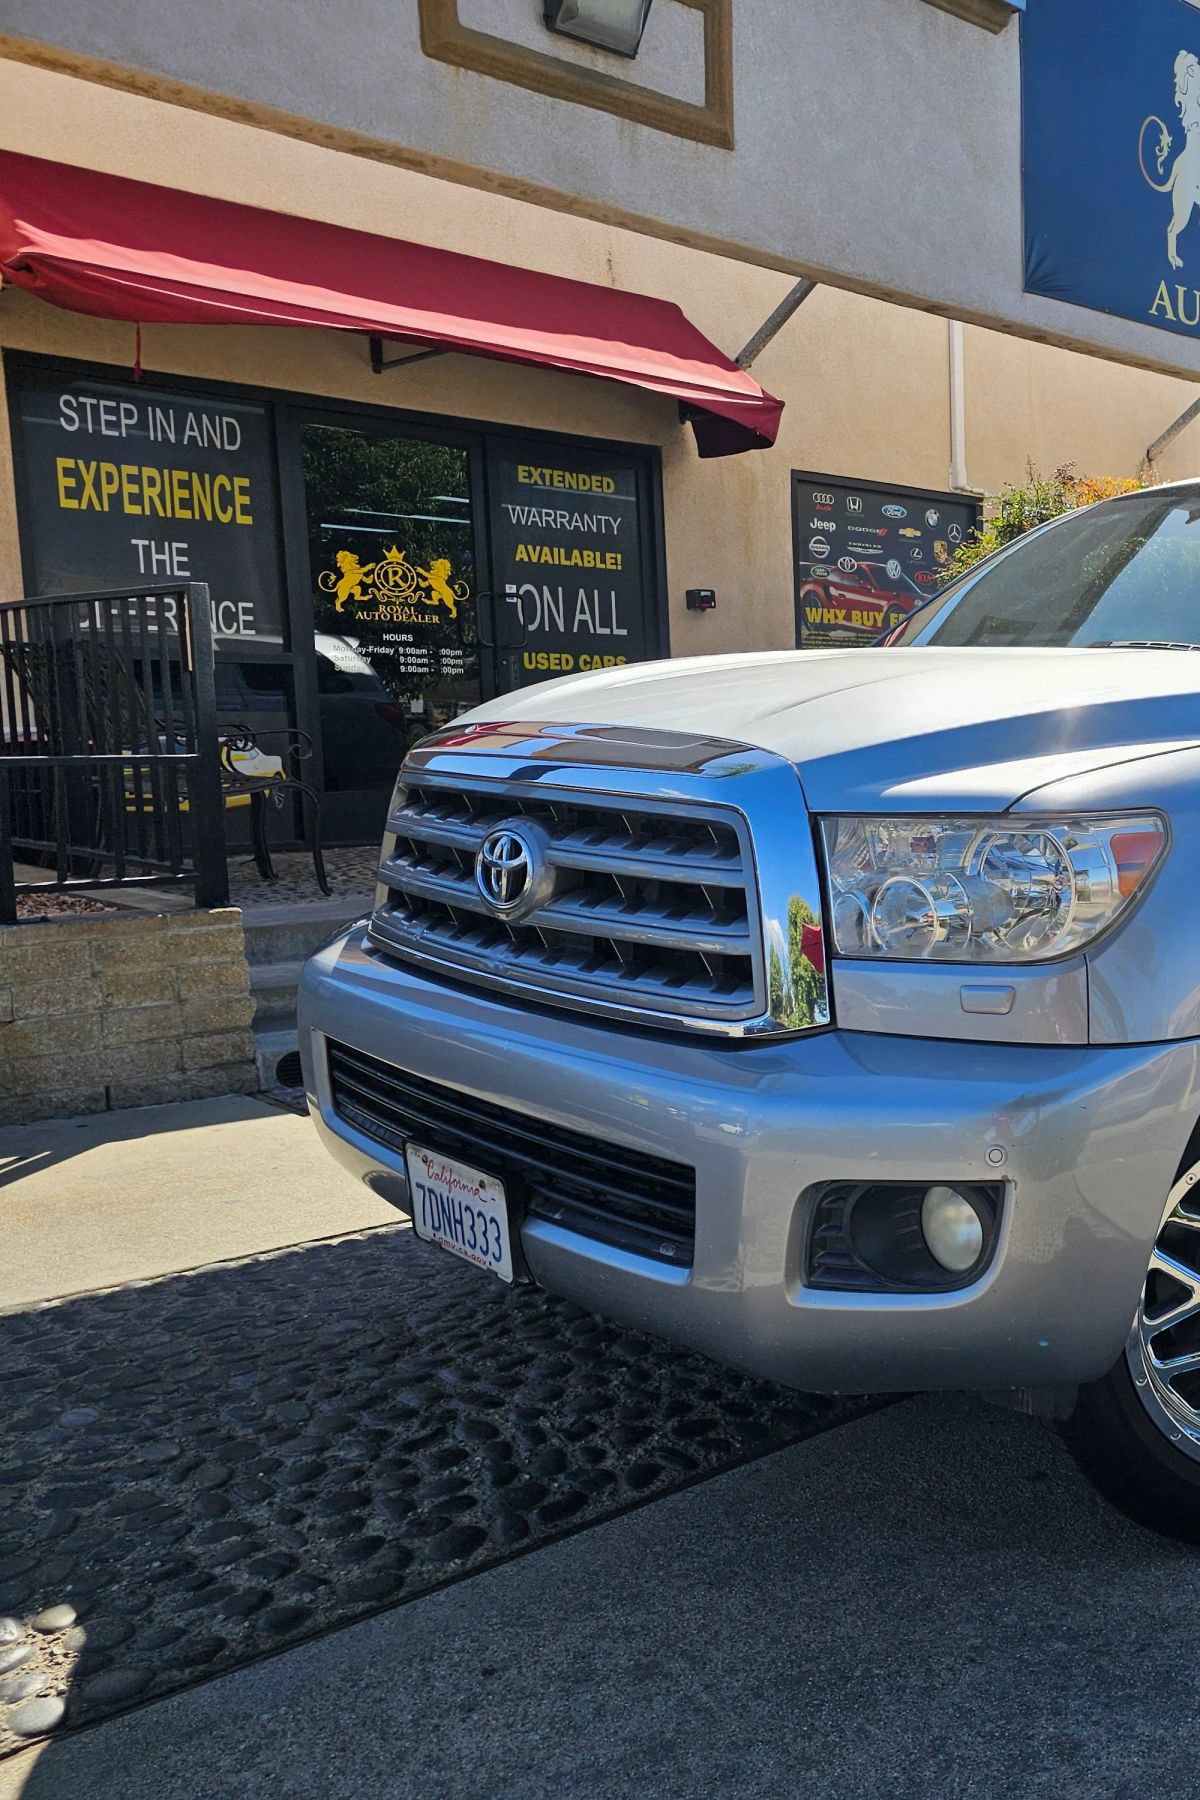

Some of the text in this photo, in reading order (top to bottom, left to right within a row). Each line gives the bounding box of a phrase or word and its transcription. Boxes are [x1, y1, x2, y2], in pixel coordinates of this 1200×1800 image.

[59, 394, 241, 451] STEP IN AND
[56, 456, 253, 525] EXPERIENCE
[517, 464, 615, 494] EXTENDED
[508, 504, 621, 535] WARRANTY
[809, 517, 837, 533] Jeep
[847, 525, 880, 534] DODGE
[130, 538, 191, 577] THE
[515, 544, 622, 570] AVAILABLE!
[355, 611, 440, 624] AUTO DEALER
[379, 604, 418, 615] ROYAL
[517, 583, 628, 636] ON ALL
[805, 607, 847, 625] WHY
[851, 610, 884, 627] BUY
[382, 633, 414, 642] HOURS
[523, 652, 574, 671] USED
[427, 1160, 486, 1201] California
[415, 1182, 502, 1263] 7DNH333
[438, 1237, 488, 1265] dmv.ca.gov
